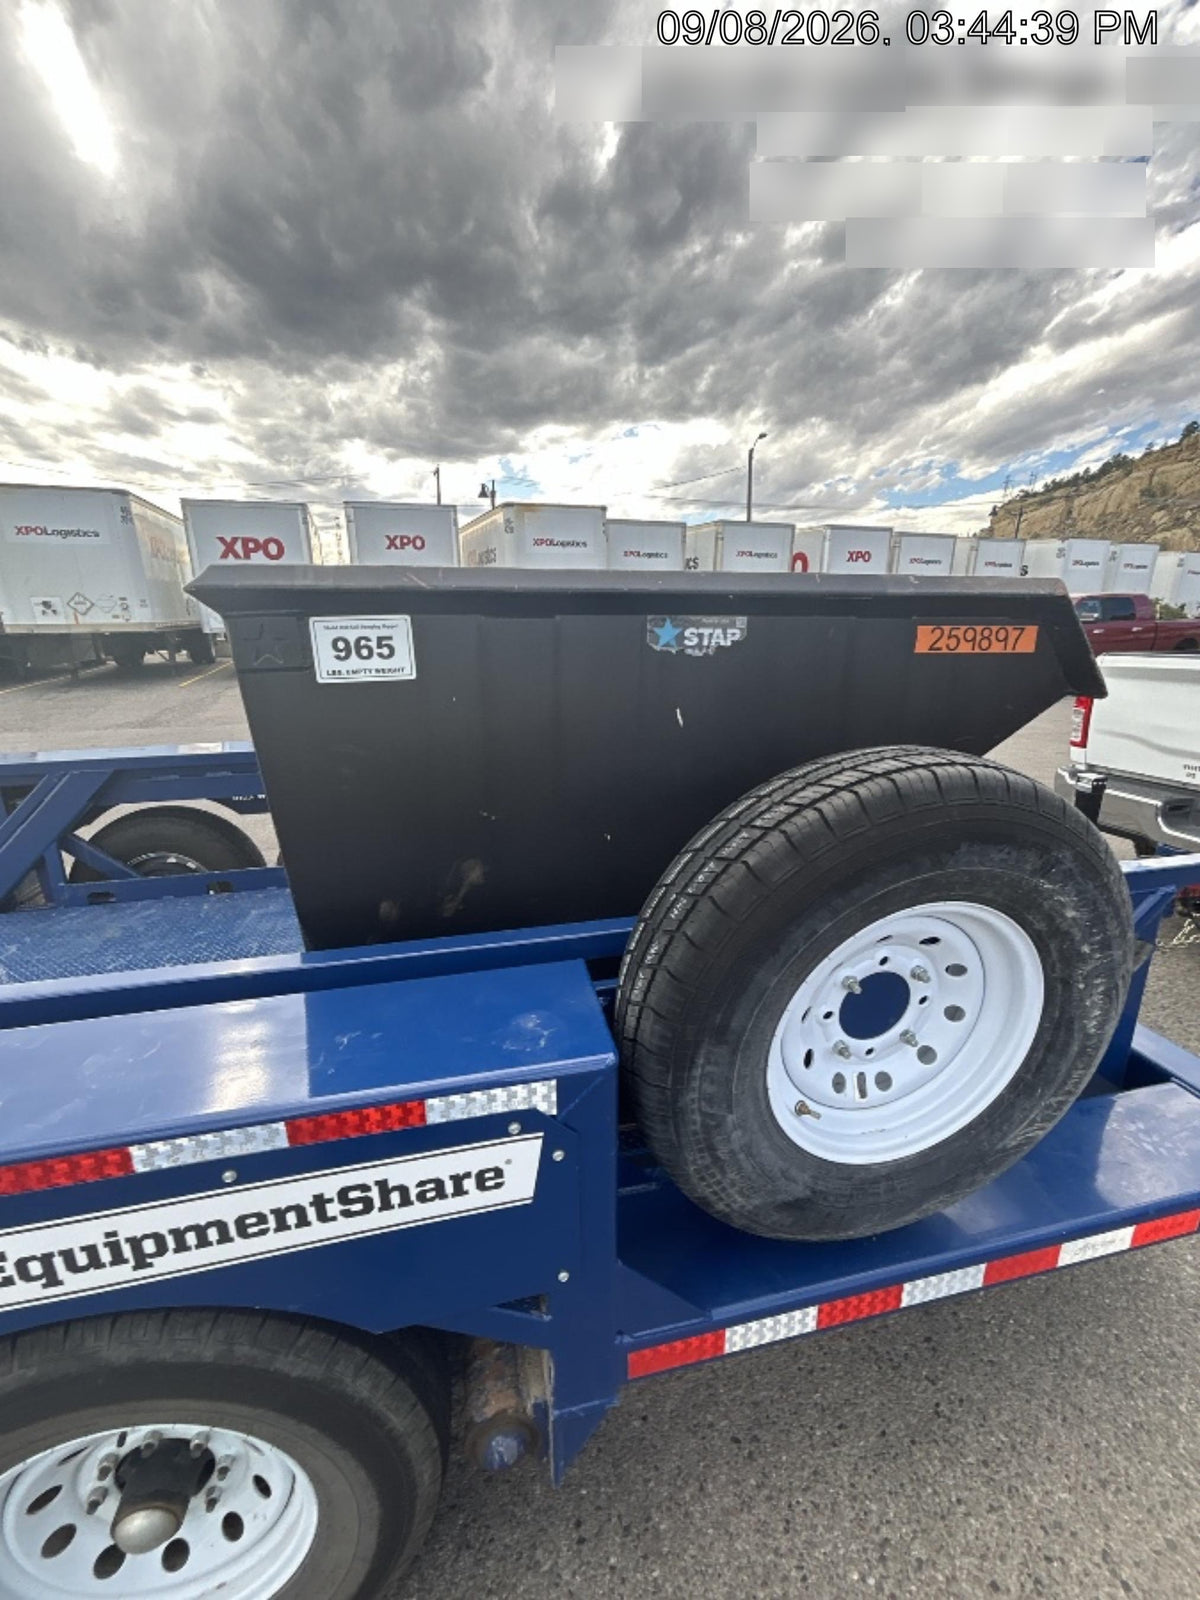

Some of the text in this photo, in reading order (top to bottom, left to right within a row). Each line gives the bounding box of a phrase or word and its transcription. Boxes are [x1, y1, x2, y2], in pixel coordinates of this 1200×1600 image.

[216, 536, 285, 561] XPO
[385, 535, 425, 551] XPO
[846, 550, 872, 563] XPO
[331, 636, 396, 661] 965
[928, 626, 1026, 652] 259897
